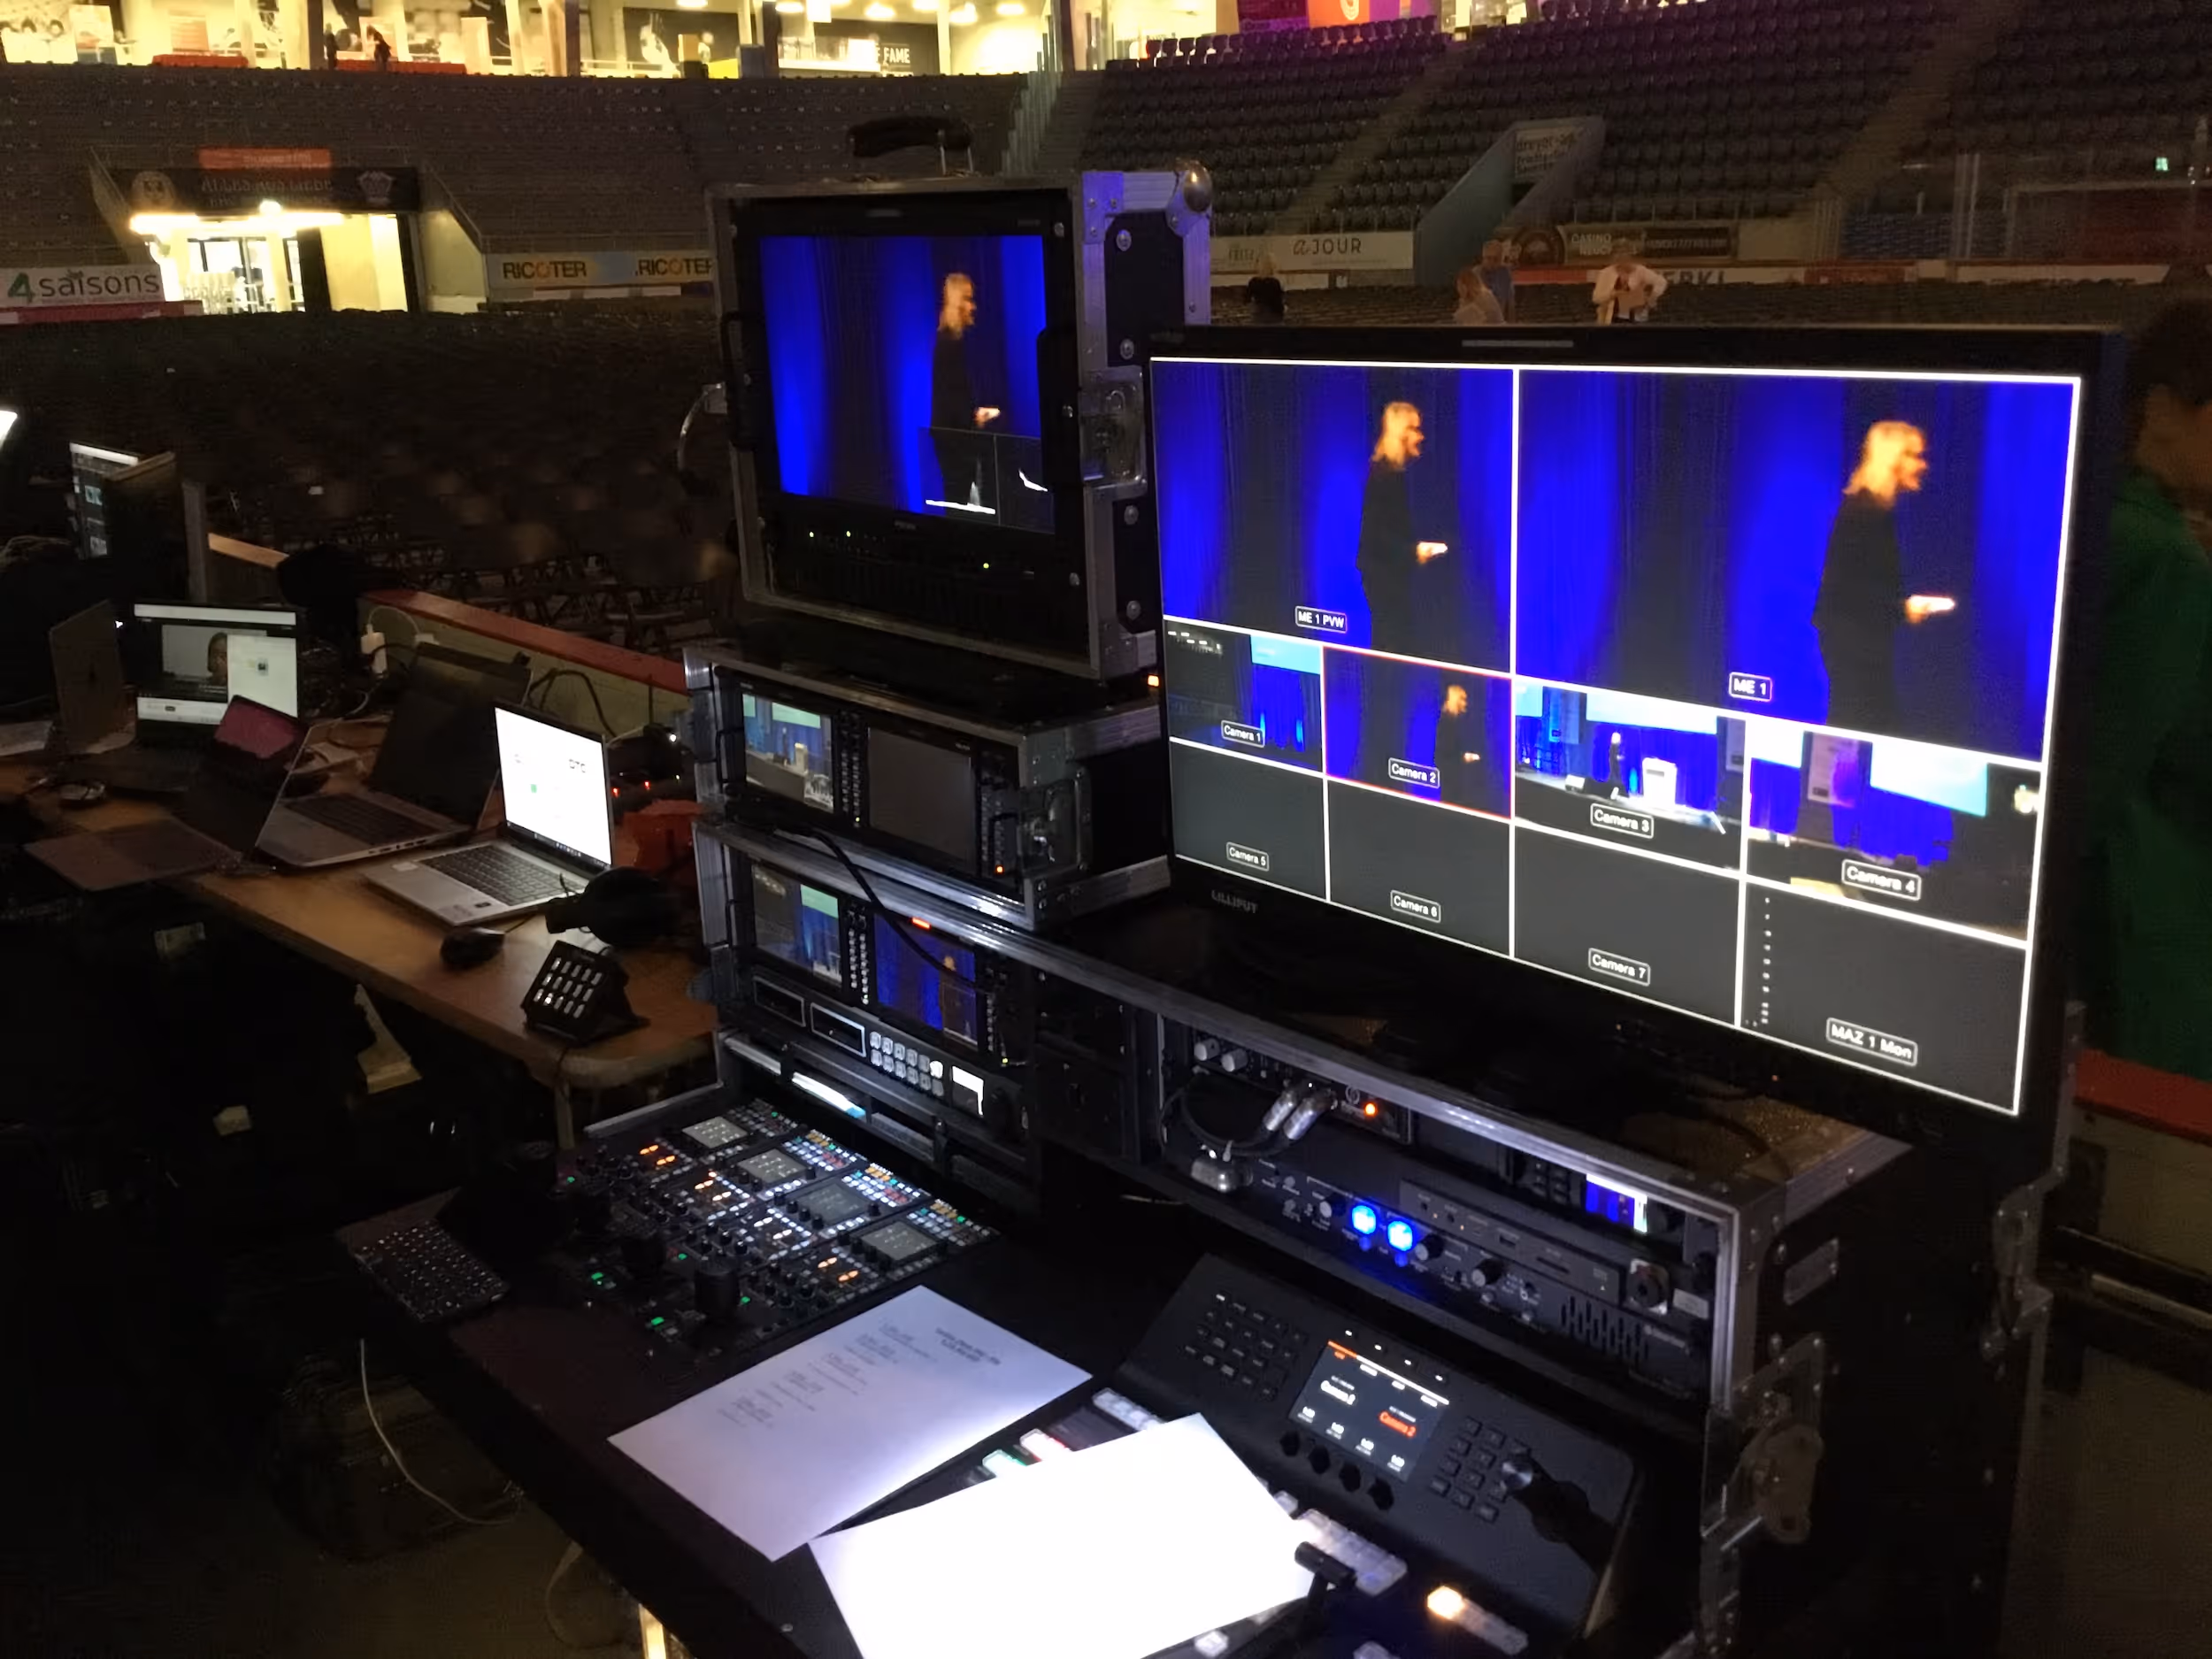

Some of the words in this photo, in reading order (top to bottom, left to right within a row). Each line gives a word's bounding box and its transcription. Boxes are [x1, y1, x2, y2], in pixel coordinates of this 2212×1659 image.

[883, 47, 910, 64] FAME
[503, 260, 587, 280] RICOTER
[8, 272, 35, 303] 4
[39, 271, 160, 297] saisons
[1298, 611, 1312, 623] ME
[1315, 613, 1320, 625] 1
[1323, 614, 1345, 628] PVW
[1734, 678, 1755, 694] ME
[1760, 682, 1766, 695] 1
[1224, 725, 1255, 741] Camera
[1256, 732, 1261, 742] 1
[1391, 763, 1427, 781] Camera
[1429, 772, 1436, 783] 2
[1594, 809, 1639, 830] Camera
[1641, 819, 1649, 833] 3
[1229, 846, 1258, 864] Camera
[1847, 865, 1901, 891] Camera
[1905, 879, 1916, 893] 4
[1211, 889, 1258, 914] LILLIPUT
[1394, 895, 1428, 915] Camera
[1431, 906, 1437, 918] 6
[1592, 954, 1635, 977] Camera
[1639, 967, 1646, 979] 7
[1832, 1024, 1863, 1045] MAZ
[1869, 1036, 1875, 1048] 1
[1880, 1038, 1911, 1059] Mon
